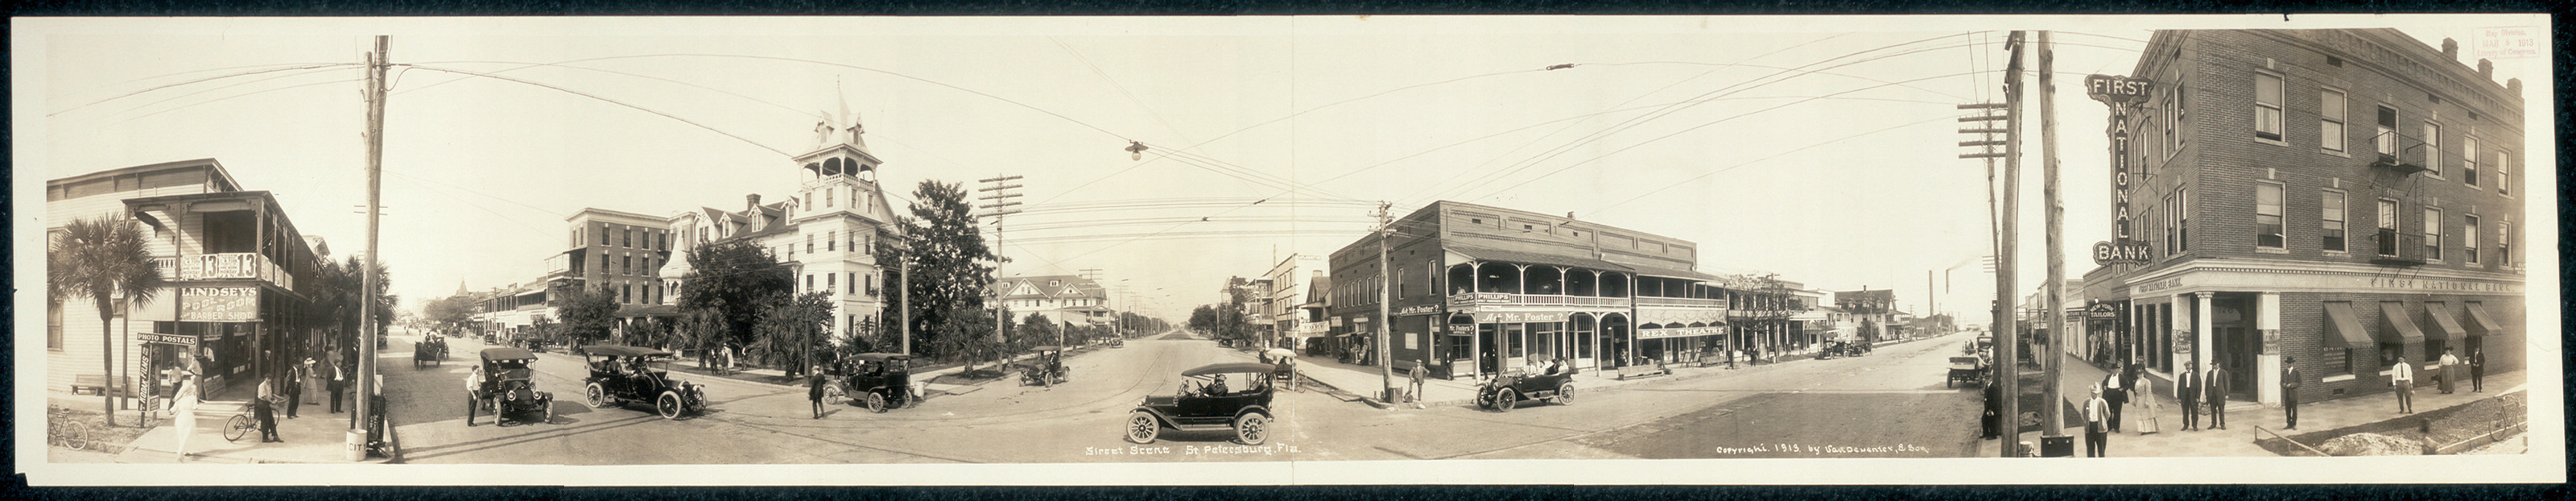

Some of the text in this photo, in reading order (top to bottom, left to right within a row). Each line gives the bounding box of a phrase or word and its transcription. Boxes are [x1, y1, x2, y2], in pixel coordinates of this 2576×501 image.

[2093, 79, 2148, 96] FIRST
[2115, 101, 2129, 238] NATIONAL
[2098, 245, 2149, 260] BANK
[200, 255, 217, 277] 13
[237, 254, 254, 277] 13
[2423, 280, 2480, 291] NATIONAL
[191, 312, 223, 320] BARBER
[2090, 304, 2115, 313] NEW YORK
[1483, 313, 1503, 322] Ask
[1525, 313, 1554, 321] Foster
[1558, 313, 1563, 321] ?
[163, 336, 195, 344] POSTALS
[140, 355, 149, 379] FILMS
[139, 379, 149, 404] KODAK
